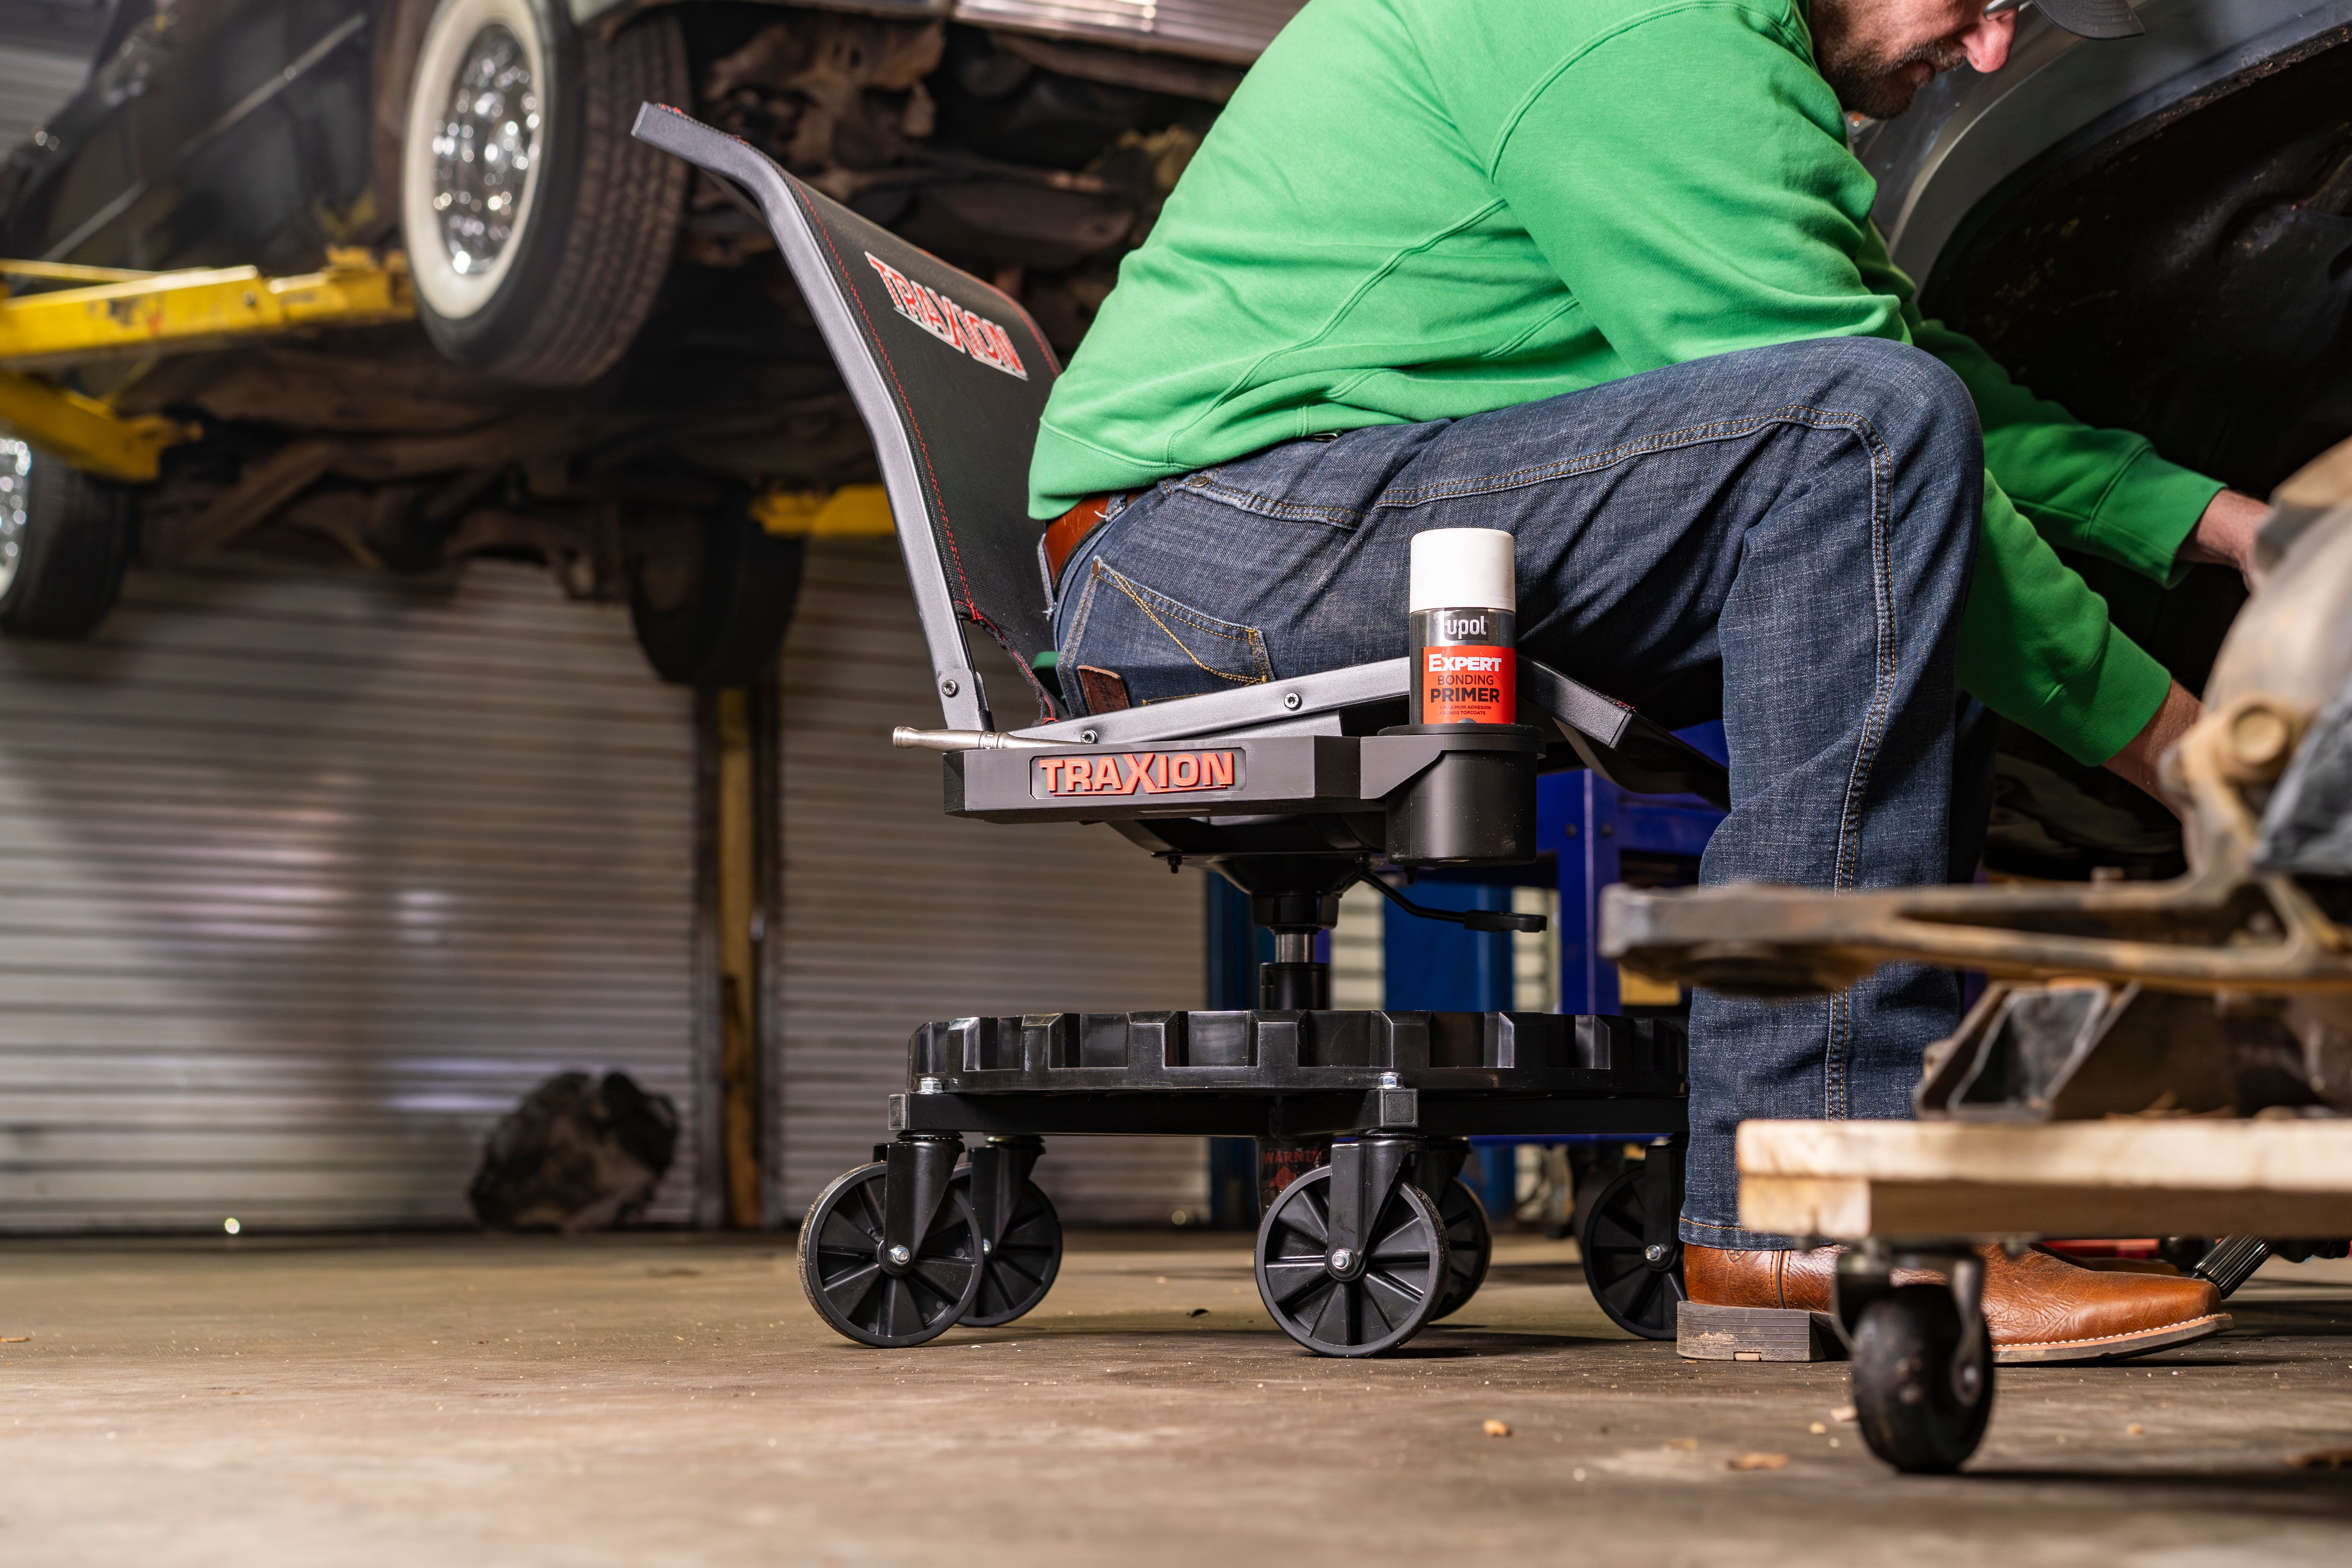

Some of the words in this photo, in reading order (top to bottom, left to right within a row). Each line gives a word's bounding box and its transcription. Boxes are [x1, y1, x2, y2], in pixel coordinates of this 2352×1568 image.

[864, 251, 1029, 381] TRAXION
[1447, 616, 1486, 639] upol
[1438, 675, 1494, 685] BONDING
[1431, 688, 1500, 702] PRIMER
[1039, 752, 1234, 795] TRAXION
